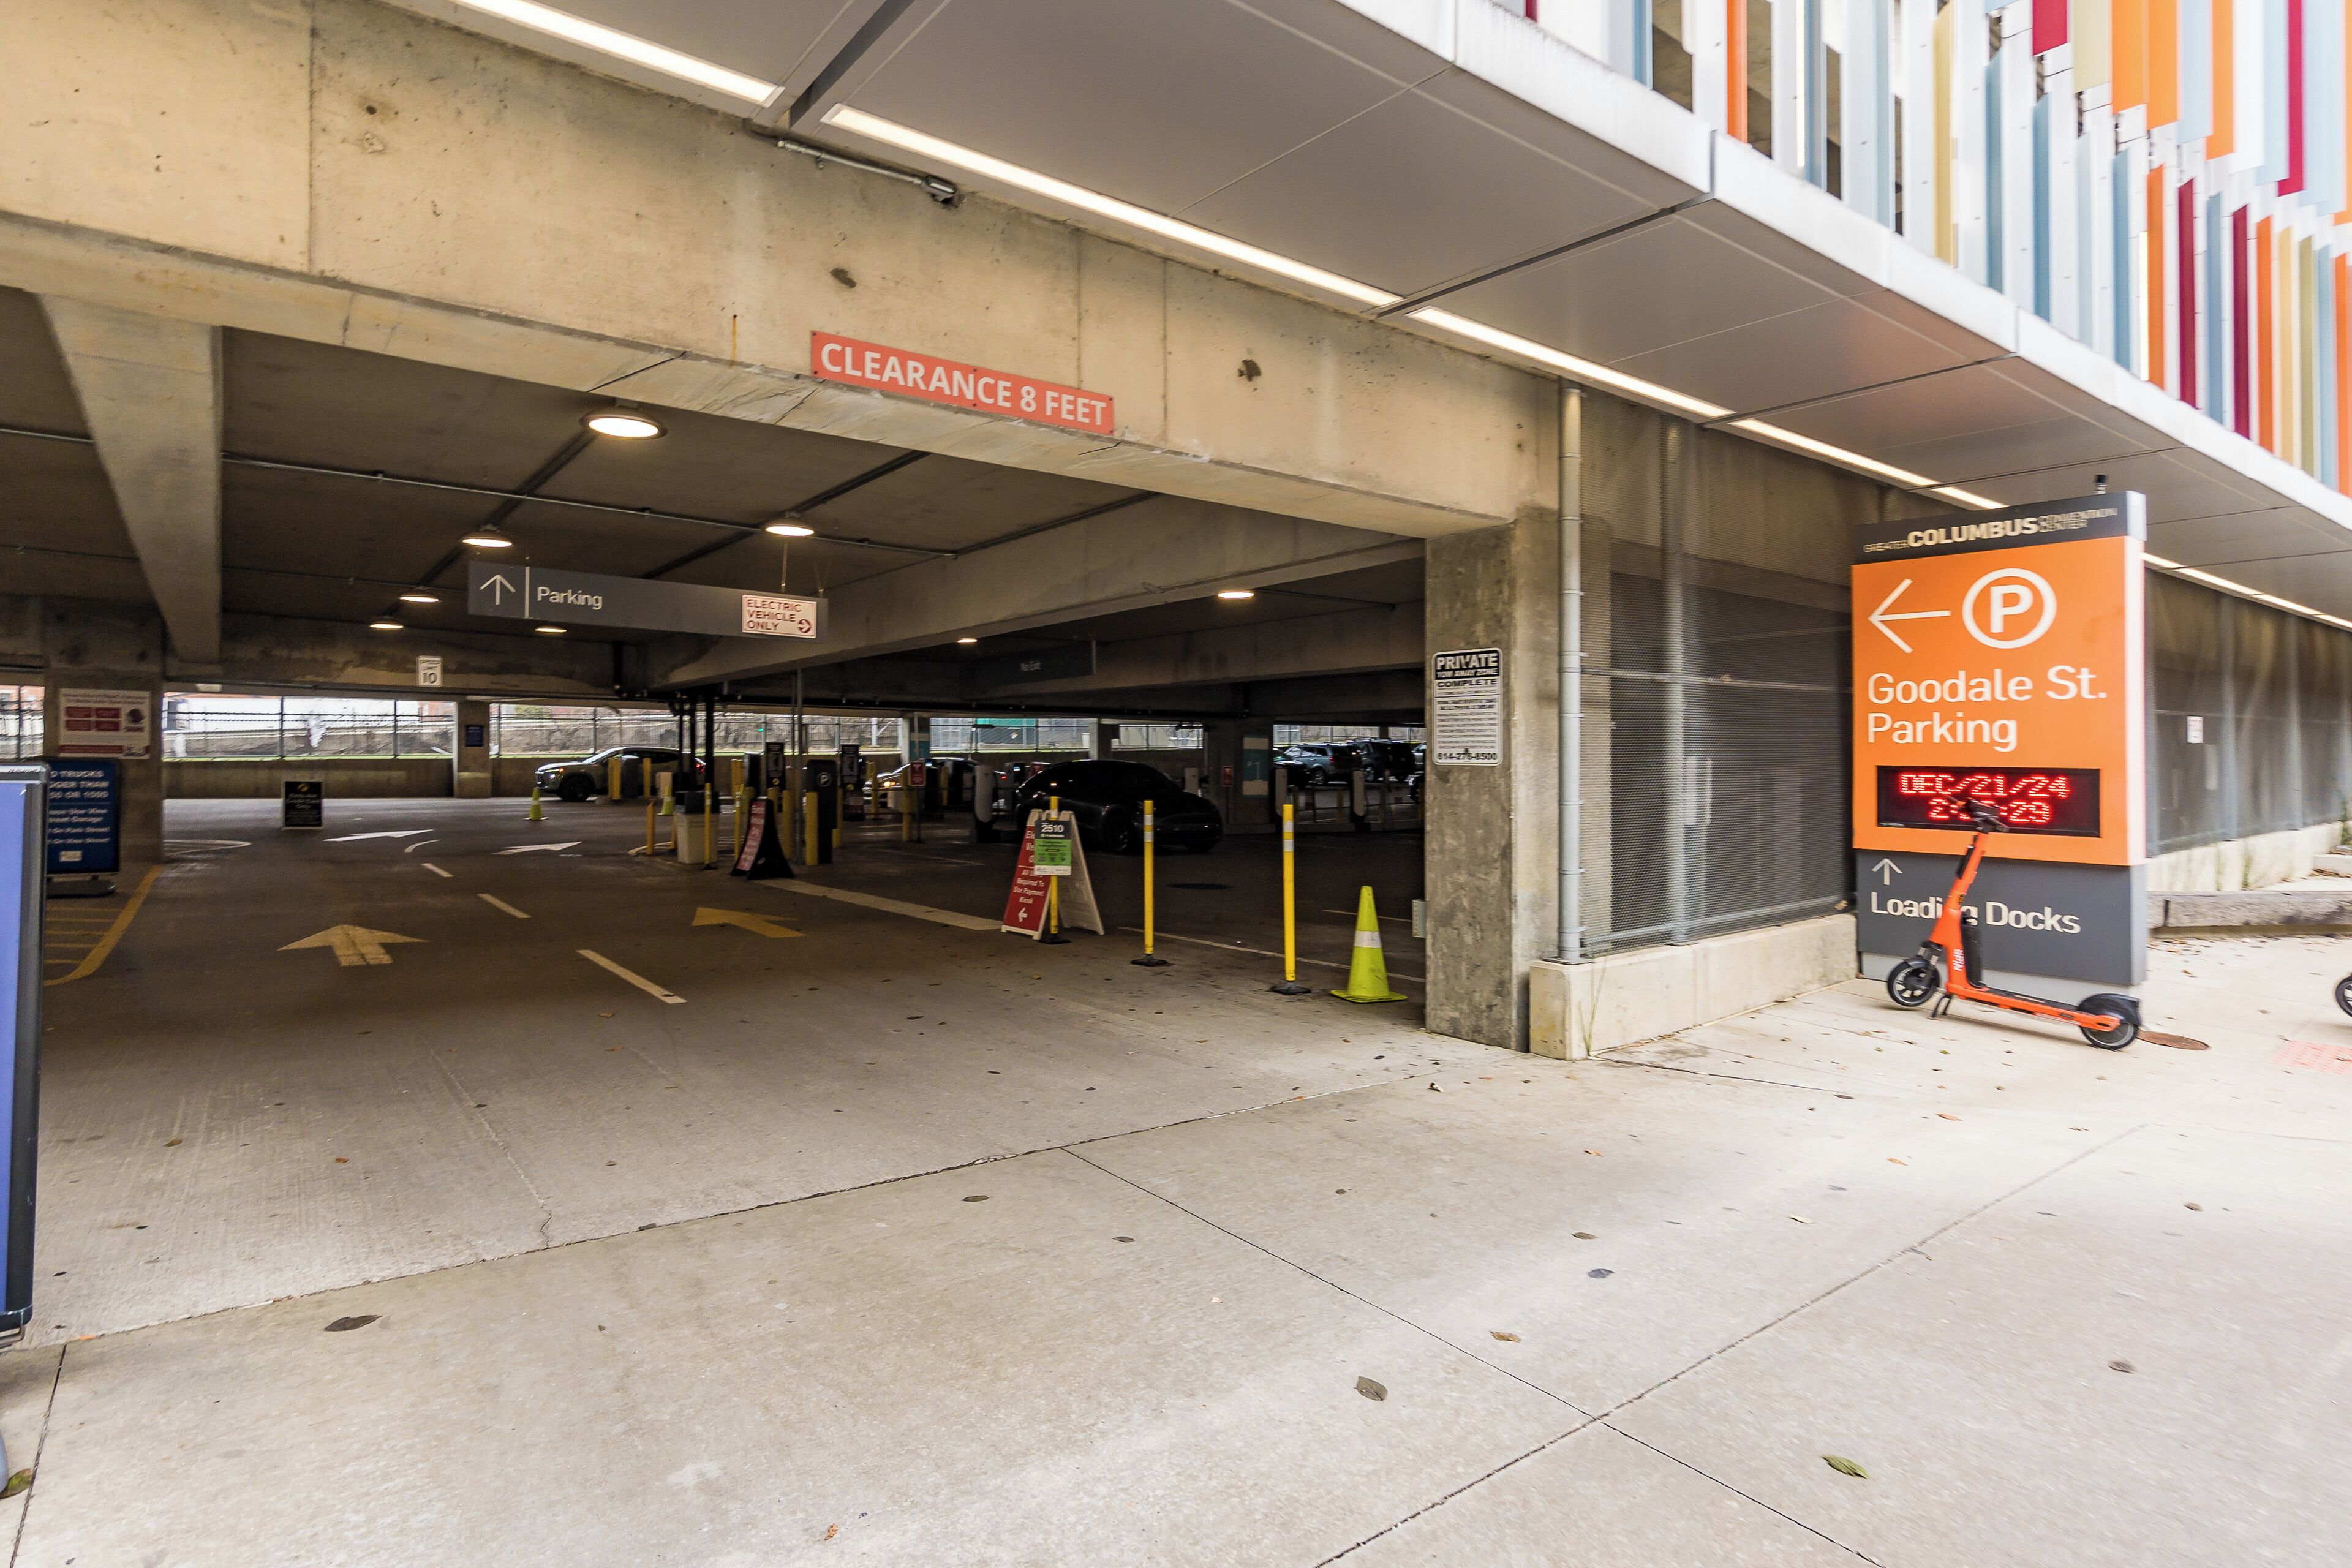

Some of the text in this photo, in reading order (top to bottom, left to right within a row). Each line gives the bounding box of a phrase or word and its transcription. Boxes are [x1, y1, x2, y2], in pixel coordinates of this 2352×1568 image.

[821, 343, 1107, 426] CLEARANCE 8 FEET
[1863, 509, 2118, 552] GREATER COLUMBUS CONVENTION
[2038, 519, 2088, 533] CENTER
[537, 586, 603, 610] Parking
[747, 599, 802, 612] ELECTRIC
[747, 610, 796, 622] VEHICLE
[747, 620, 779, 631] ONLY
[1436, 653, 1498, 670] PRIVATE
[423, 673, 437, 684] 10
[1437, 678, 1498, 688] COMPLETE
[1868, 665, 2108, 704] Goodale St.
[1868, 712, 2018, 753] Parking
[1900, 774, 2070, 798] DEC/21/24
[1929, 798, 2050, 823] 2::29
[1041, 824, 1065, 833] 2510
[1871, 891, 2081, 935] Loadig Docks
